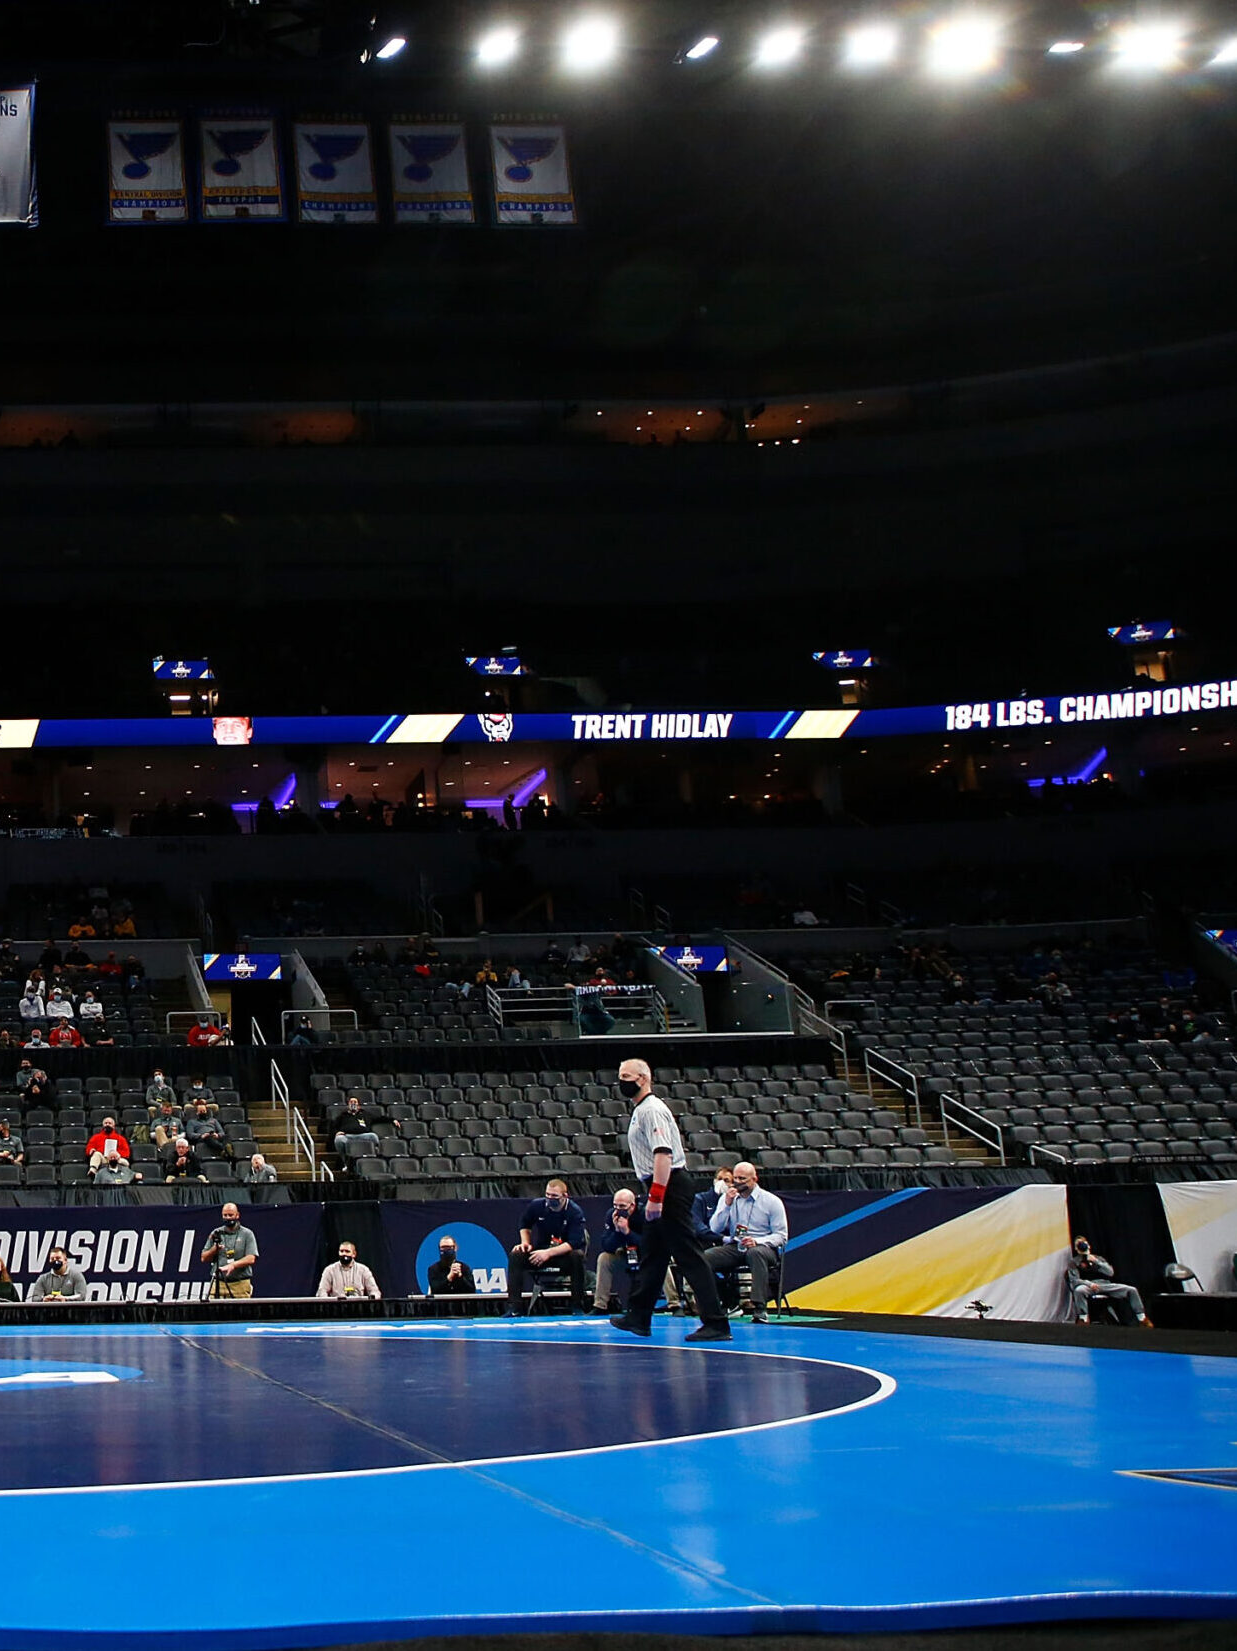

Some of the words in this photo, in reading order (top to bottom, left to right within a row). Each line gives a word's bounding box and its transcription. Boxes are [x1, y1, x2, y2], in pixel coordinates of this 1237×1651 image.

[114, 200, 185, 208] CHAMPIONS
[572, 714, 647, 740] TRENT
[651, 714, 733, 739] HIDLAY
[945, 703, 991, 730] 184
[996, 699, 1052, 727] LBS.
[178, 1230, 196, 1273] I
[472, 1268, 509, 1293] AA
